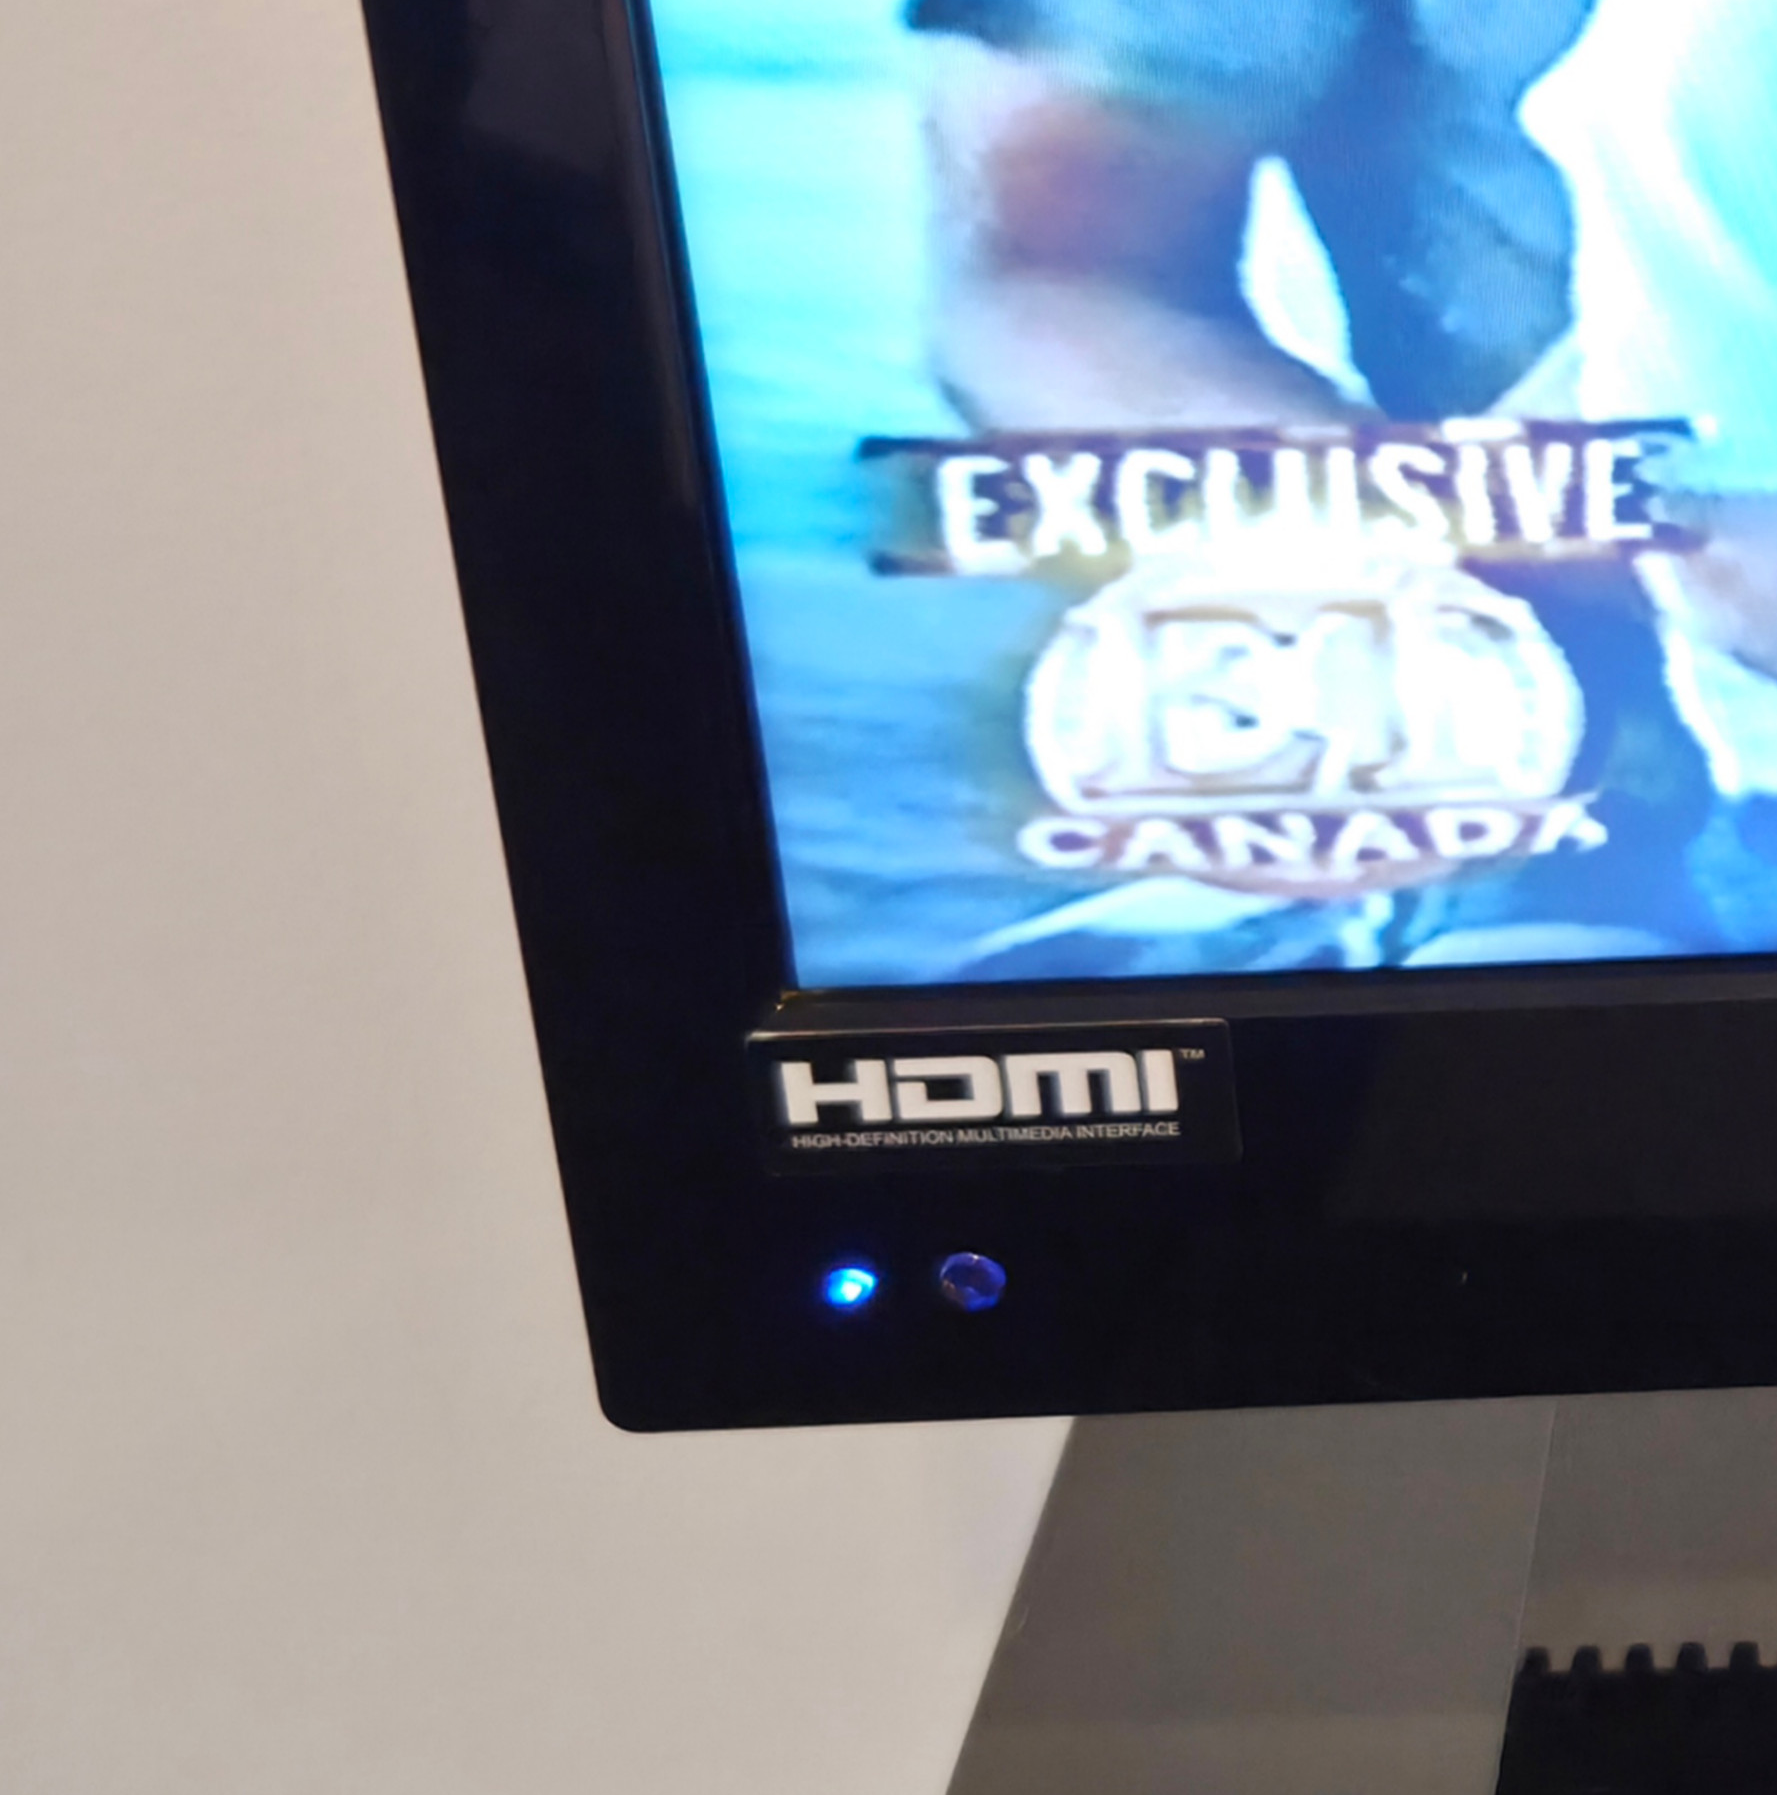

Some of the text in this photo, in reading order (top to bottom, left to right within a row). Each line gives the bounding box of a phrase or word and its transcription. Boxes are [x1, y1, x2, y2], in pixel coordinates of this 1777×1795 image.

[933, 436, 1654, 575] EXCLUSIVE
[1016, 802, 1608, 875] CANADA
[781, 1049, 1179, 1124] HDMI
[792, 1122, 1181, 1148] HIGH-DEFINITION MULTIMEDIA INTERFACE
